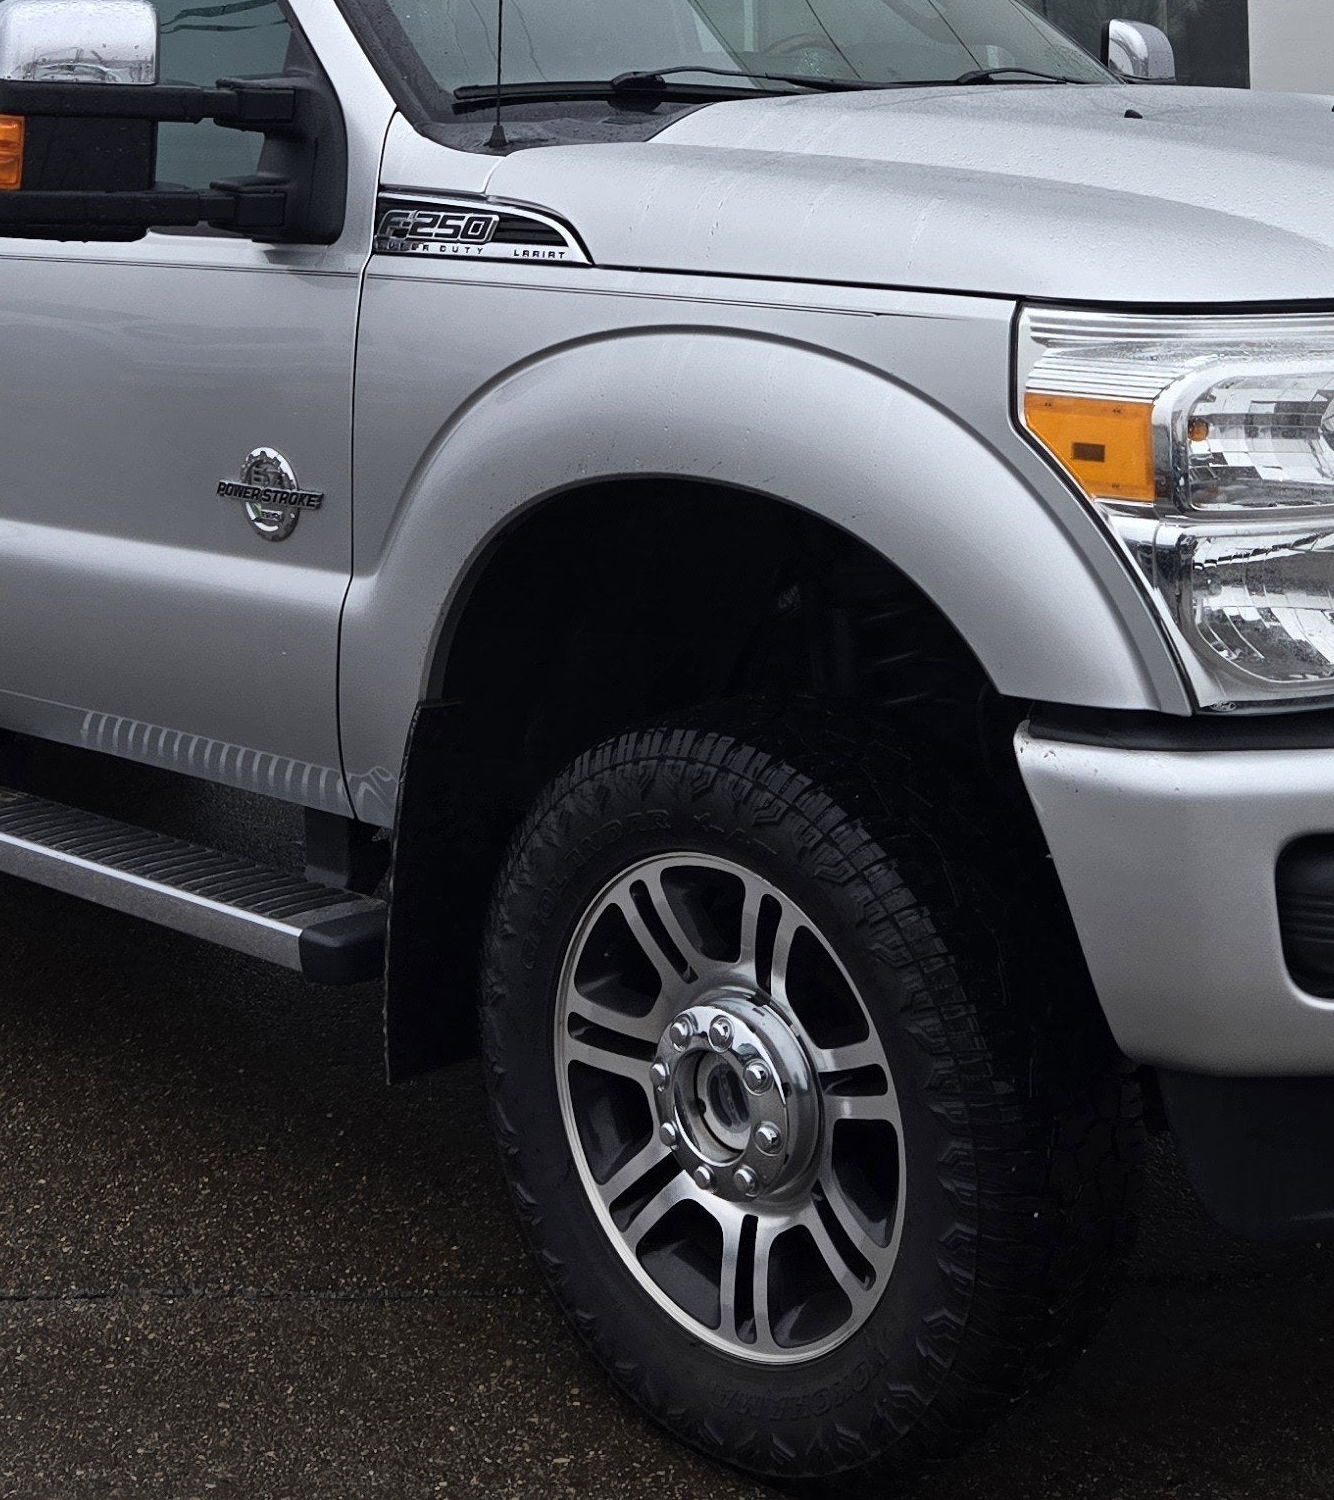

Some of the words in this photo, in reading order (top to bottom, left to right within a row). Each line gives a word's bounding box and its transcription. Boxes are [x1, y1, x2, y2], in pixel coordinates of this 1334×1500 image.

[377, 209, 499, 245] F-250
[440, 244, 484, 254] DUTY
[513, 248, 567, 259] LARIAT
[217, 481, 261, 501] POWER
[261, 488, 323, 509] STROKE
